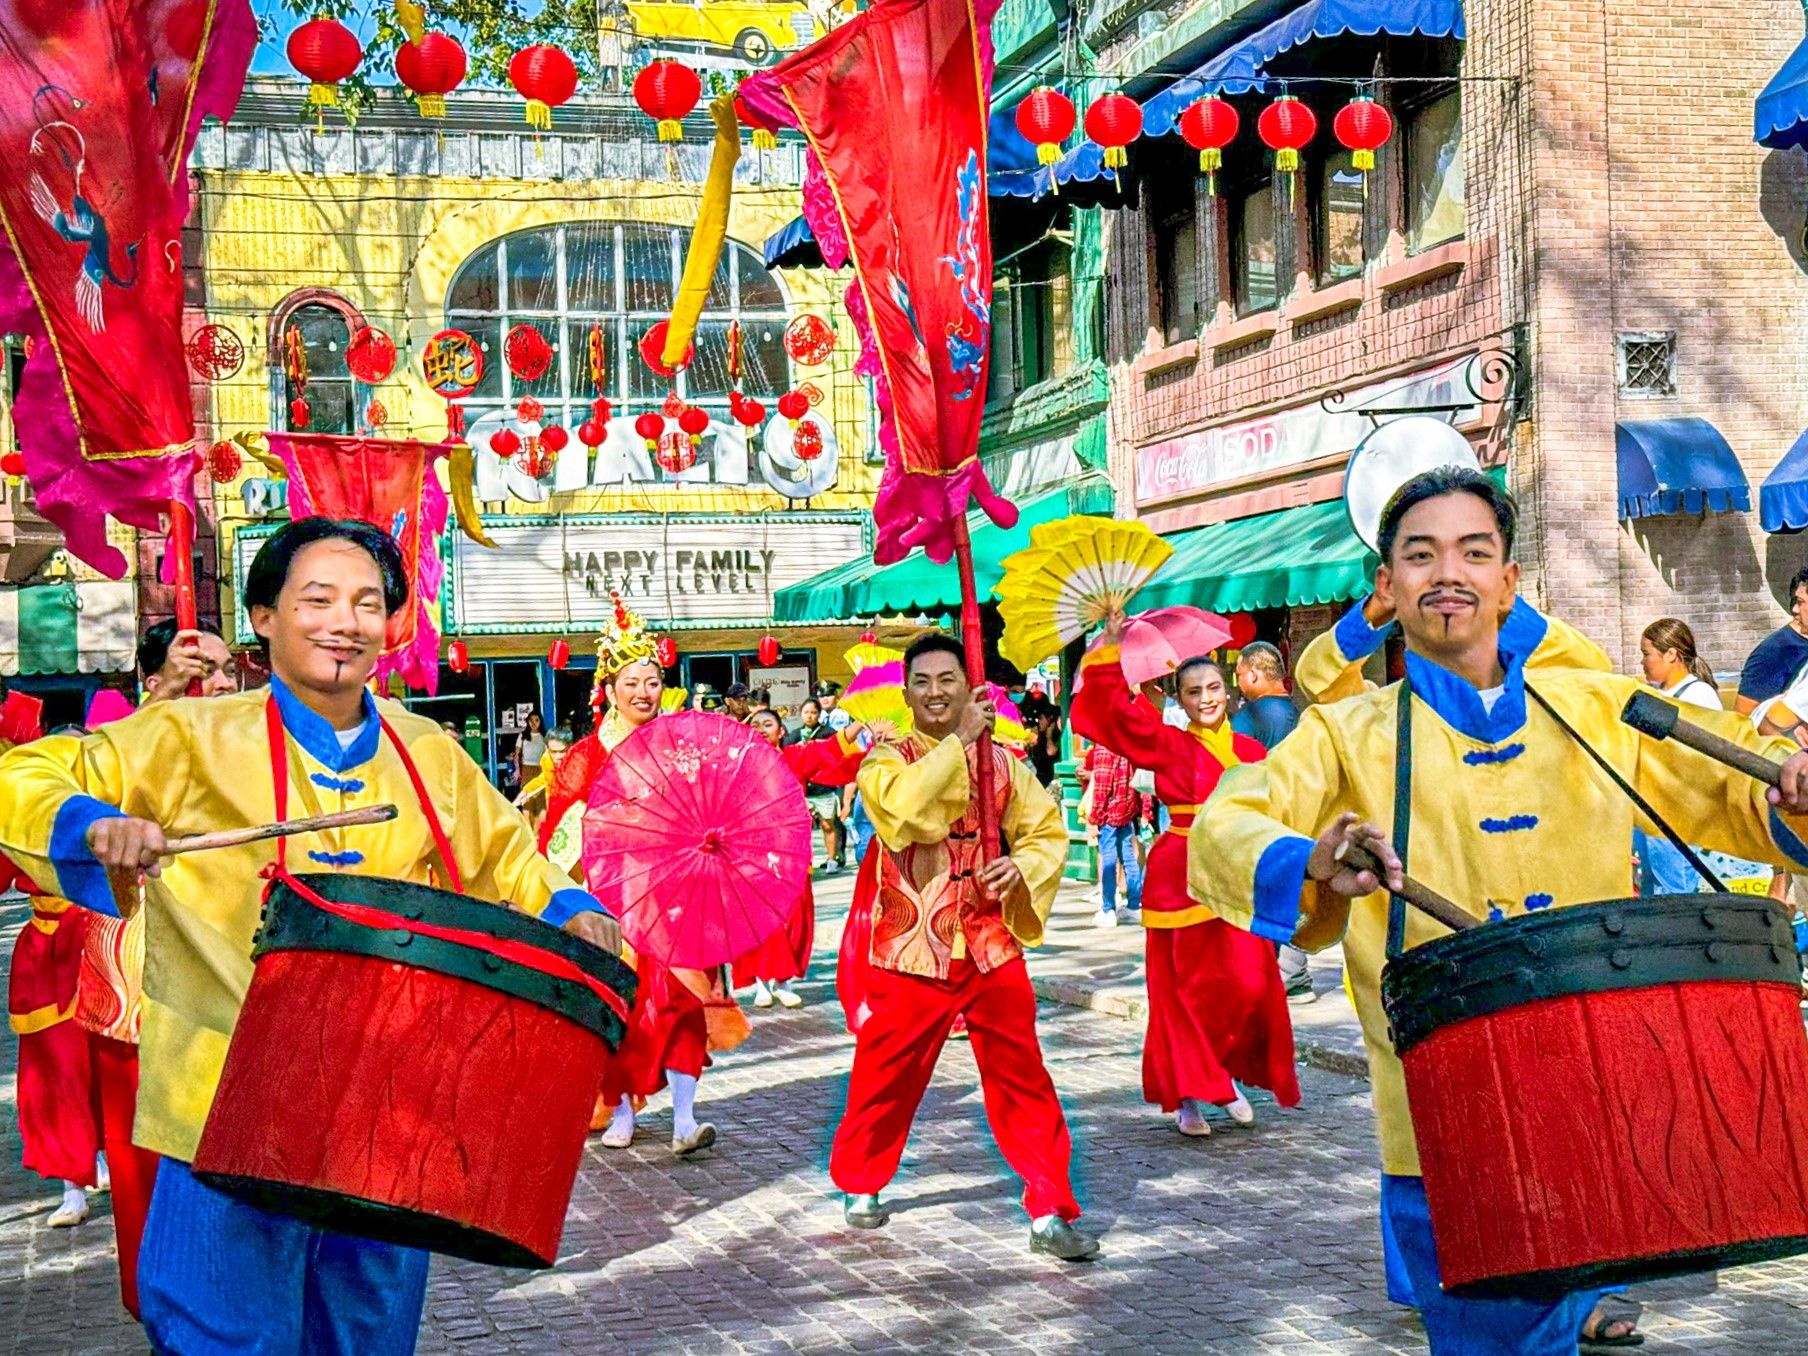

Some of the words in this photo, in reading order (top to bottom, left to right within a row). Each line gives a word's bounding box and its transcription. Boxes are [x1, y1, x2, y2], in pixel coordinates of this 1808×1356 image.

[423, 336, 480, 389] 蛇
[564, 550, 658, 575] HAPPY
[676, 550, 775, 573] FAMILY
[586, 575, 651, 596] NEXT
[676, 574, 755, 594] LEVEL
